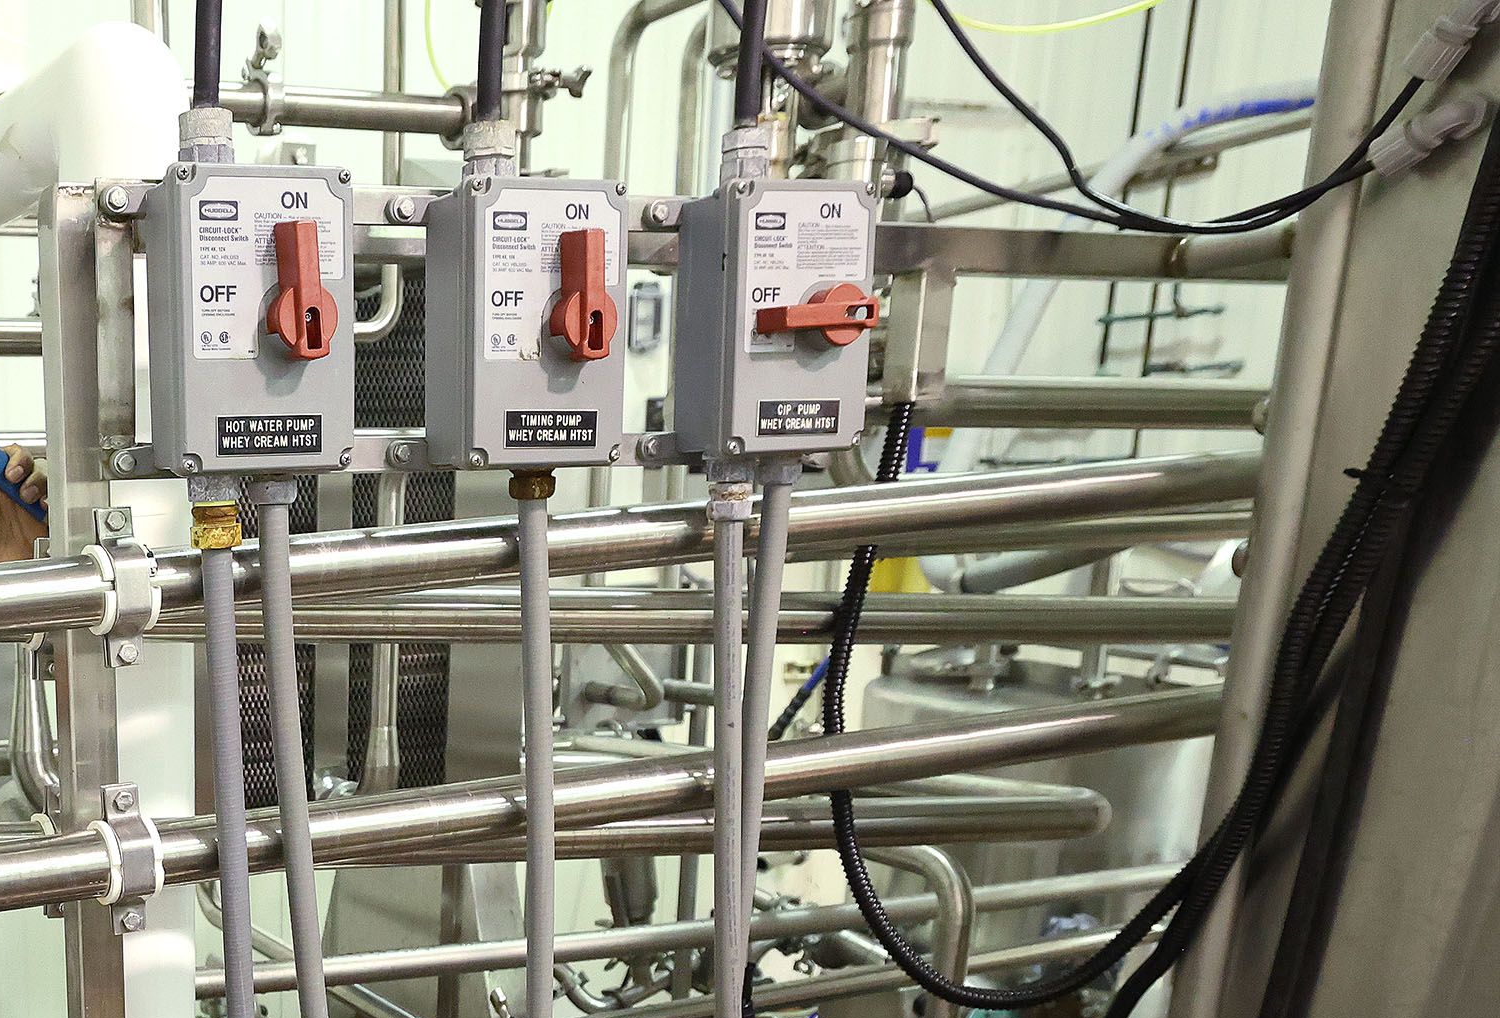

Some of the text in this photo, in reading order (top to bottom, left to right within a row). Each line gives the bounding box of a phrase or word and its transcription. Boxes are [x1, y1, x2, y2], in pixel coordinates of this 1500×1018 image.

[281, 191, 308, 209] ON
[565, 203, 589, 220] ON
[820, 203, 841, 219] ON
[200, 285, 237, 302] OFF
[491, 291, 524, 307] OFF
[752, 287, 781, 303] OFF
[777, 403, 821, 416] CIP PUMP
[226, 419, 315, 433] HOT WATER PUMP
[521, 415, 582, 426] TIMING PUMP
[760, 417, 836, 430] WHEY CREAM HTST
[222, 434, 318, 448] WHEY CREAM HTST
[509, 429, 593, 441] WHEY CREAM HTST
